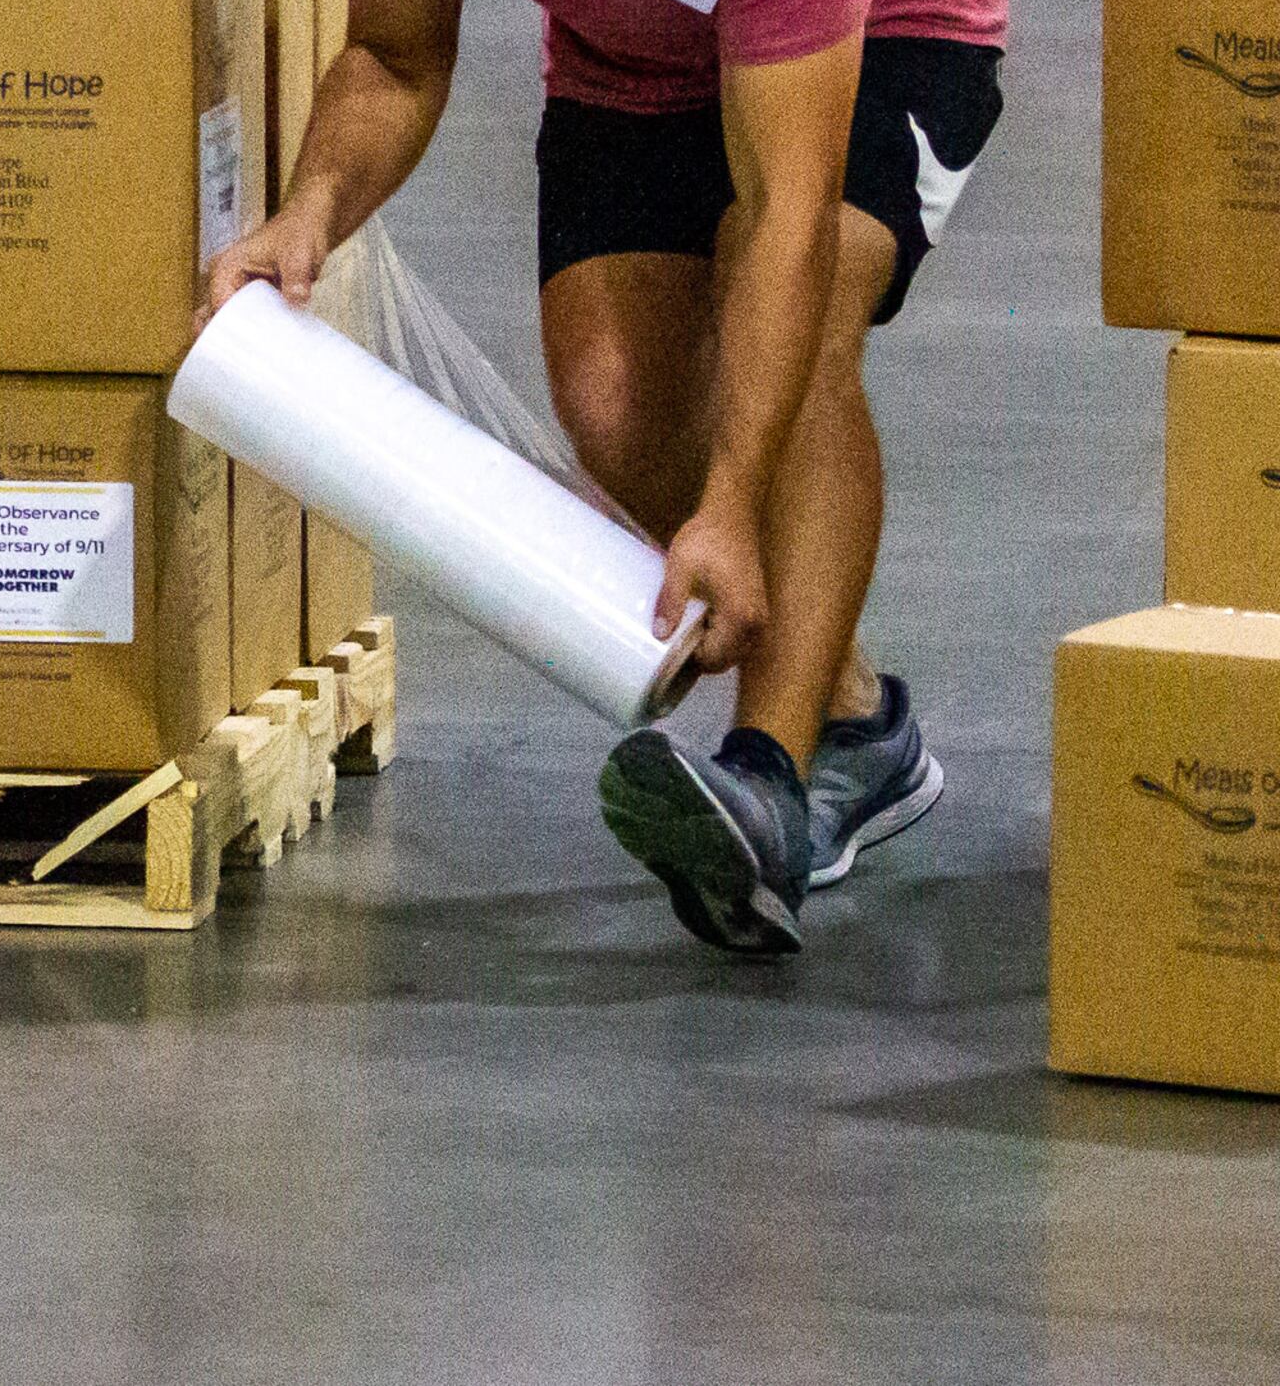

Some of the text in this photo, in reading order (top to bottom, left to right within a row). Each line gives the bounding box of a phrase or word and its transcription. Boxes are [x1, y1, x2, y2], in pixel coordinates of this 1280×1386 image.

[23, 70, 104, 100] Hope
[7, 442, 34, 464] of
[37, 441, 96, 465] Hope
[0, 521, 29, 537] the
[53, 539, 72, 554] of
[75, 539, 106, 555] 9/11
[1172, 758, 1252, 794] Meals
